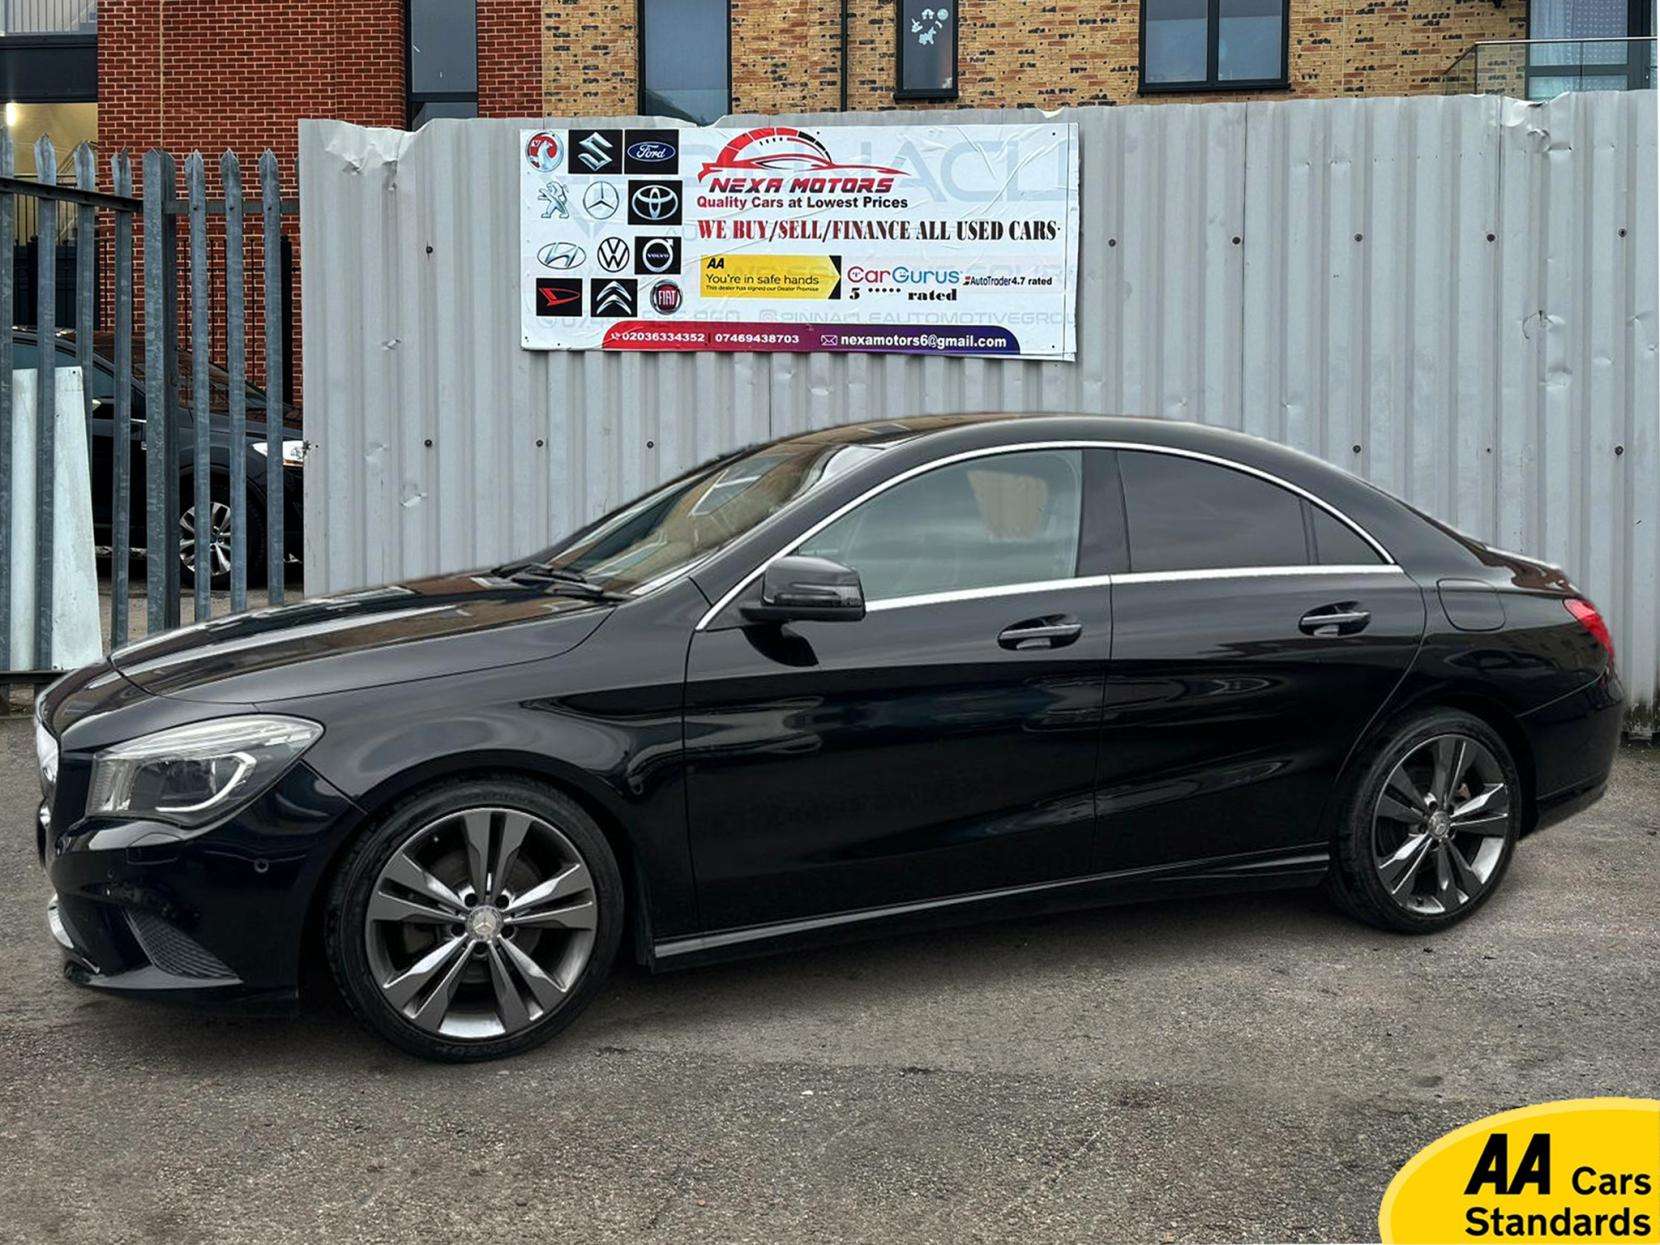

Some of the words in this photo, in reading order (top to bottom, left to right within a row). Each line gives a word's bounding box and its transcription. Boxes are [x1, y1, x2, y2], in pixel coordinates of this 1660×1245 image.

[636, 143, 666, 159] Ford
[708, 177, 783, 194] NEXA
[789, 177, 894, 194] MOTORS
[696, 195, 747, 211] Quality
[751, 196, 784, 208] Cars
[788, 197, 802, 208] at
[807, 196, 859, 209] Lowest
[863, 196, 908, 209] Prices
[697, 219, 727, 240] WE
[733, 219, 911, 243] BUY/SELL/FINANCE
[916, 220, 951, 241] ALL
[956, 220, 1004, 241] USED
[1008, 220, 1057, 241] CARS
[706, 257, 725, 269] AA
[706, 273, 741, 285] You're
[743, 273, 754, 284] in
[757, 274, 781, 285] safe
[784, 274, 820, 286] hands
[847, 265, 960, 284] CarGurus
[1027, 276, 1053, 286] rated
[658, 290, 676, 306] FIAT
[849, 287, 861, 300] 5
[907, 288, 958, 301] rated
[622, 332, 705, 343] 02036334352
[714, 333, 800, 344] 07469438703
[840, 334, 1007, 349] nexamotors6@gmail.com
